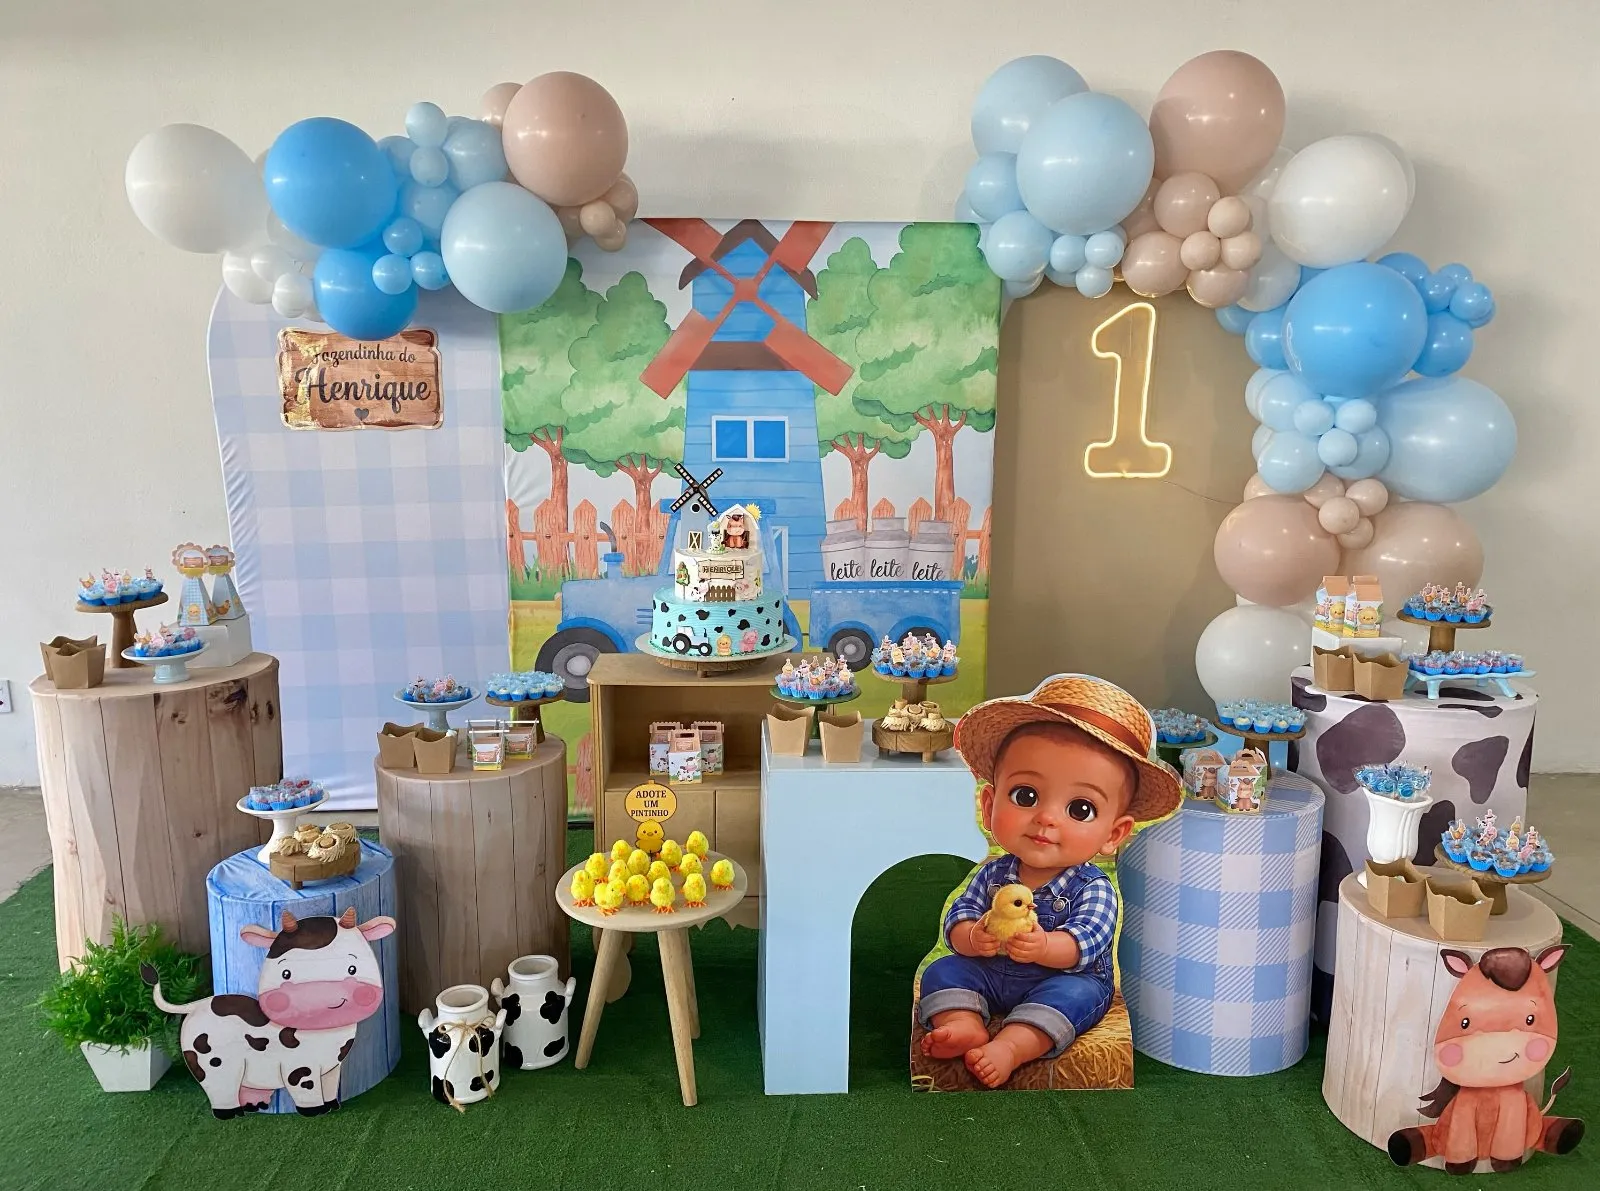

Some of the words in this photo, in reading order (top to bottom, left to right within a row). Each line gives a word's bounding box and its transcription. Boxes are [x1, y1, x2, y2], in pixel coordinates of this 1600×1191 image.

[399, 346, 417, 363] do
[294, 367, 431, 414] Henrique
[1084, 302, 1172, 478] 1
[702, 565, 741, 574] HENRIQUE
[831, 559, 864, 581] leite
[870, 559, 904, 578] leite
[911, 561, 945, 581] leite
[635, 790, 667, 799] ADOTE
[643, 800, 659, 808] UM
